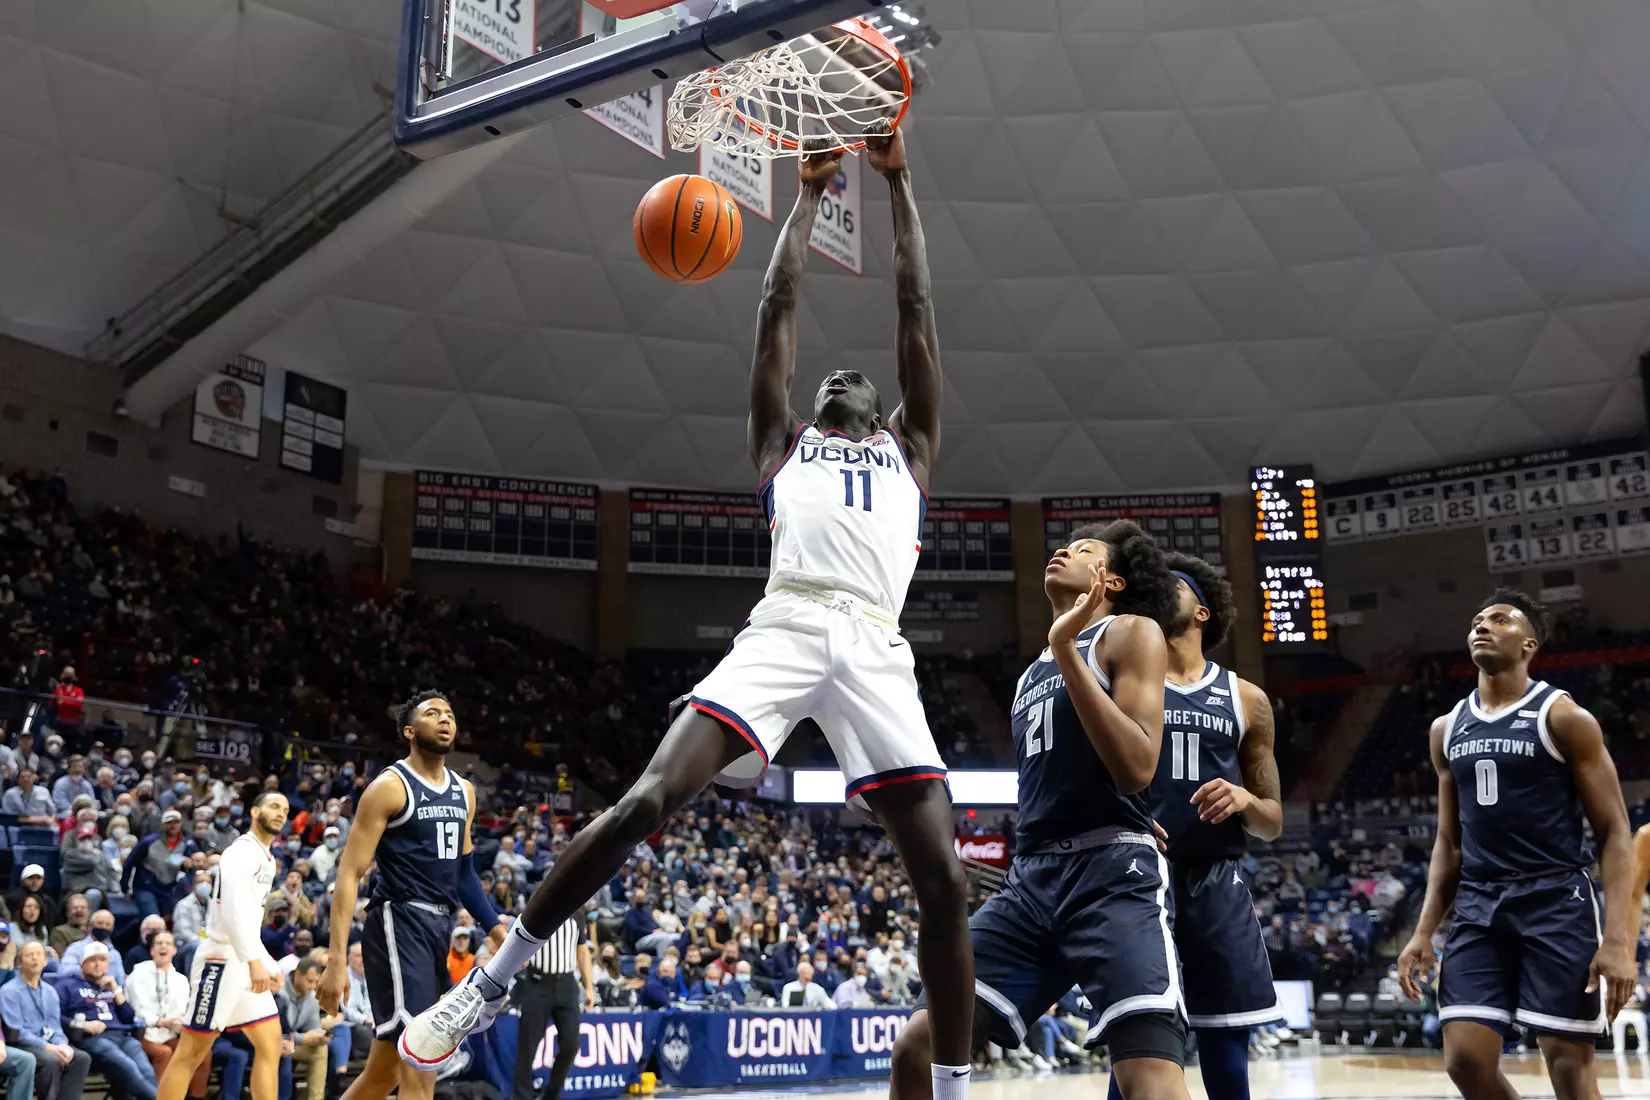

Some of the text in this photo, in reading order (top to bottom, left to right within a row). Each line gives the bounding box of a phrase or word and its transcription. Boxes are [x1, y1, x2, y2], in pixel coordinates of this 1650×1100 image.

[708, 170, 765, 212] CHAMPIONS
[712, 156, 762, 194] NATIONAL
[690, 197, 705, 235] UCONN
[821, 196, 854, 234] 016
[812, 233, 856, 268] HAMPIONS
[800, 445, 901, 474] UCONN
[418, 472, 595, 497] BIG EAST CONFERENCE
[840, 469, 872, 512] 11
[1530, 488, 1558, 505] 44
[1616, 475, 1646, 493] 42
[1408, 506, 1434, 524] 22
[1488, 494, 1517, 511] 42
[1336, 518, 1351, 534] C
[1579, 532, 1606, 551] 22
[1493, 543, 1521, 562] 24
[1540, 538, 1561, 555] 13
[1014, 674, 1066, 715] GEORGETO
[1026, 697, 1054, 758] 21
[1164, 709, 1234, 737] RGETOWN
[220, 741, 249, 759] 109
[1171, 731, 1200, 781] 11
[1449, 738, 1536, 761] GEORGETOWN
[1475, 759, 1499, 806] 0
[436, 822, 459, 860] 13
[196, 965, 220, 1026] HUSKIES
[727, 1017, 822, 1058] UCONN
[851, 1015, 909, 1054] UCO
[740, 1062, 809, 1078] BASKETBALL
